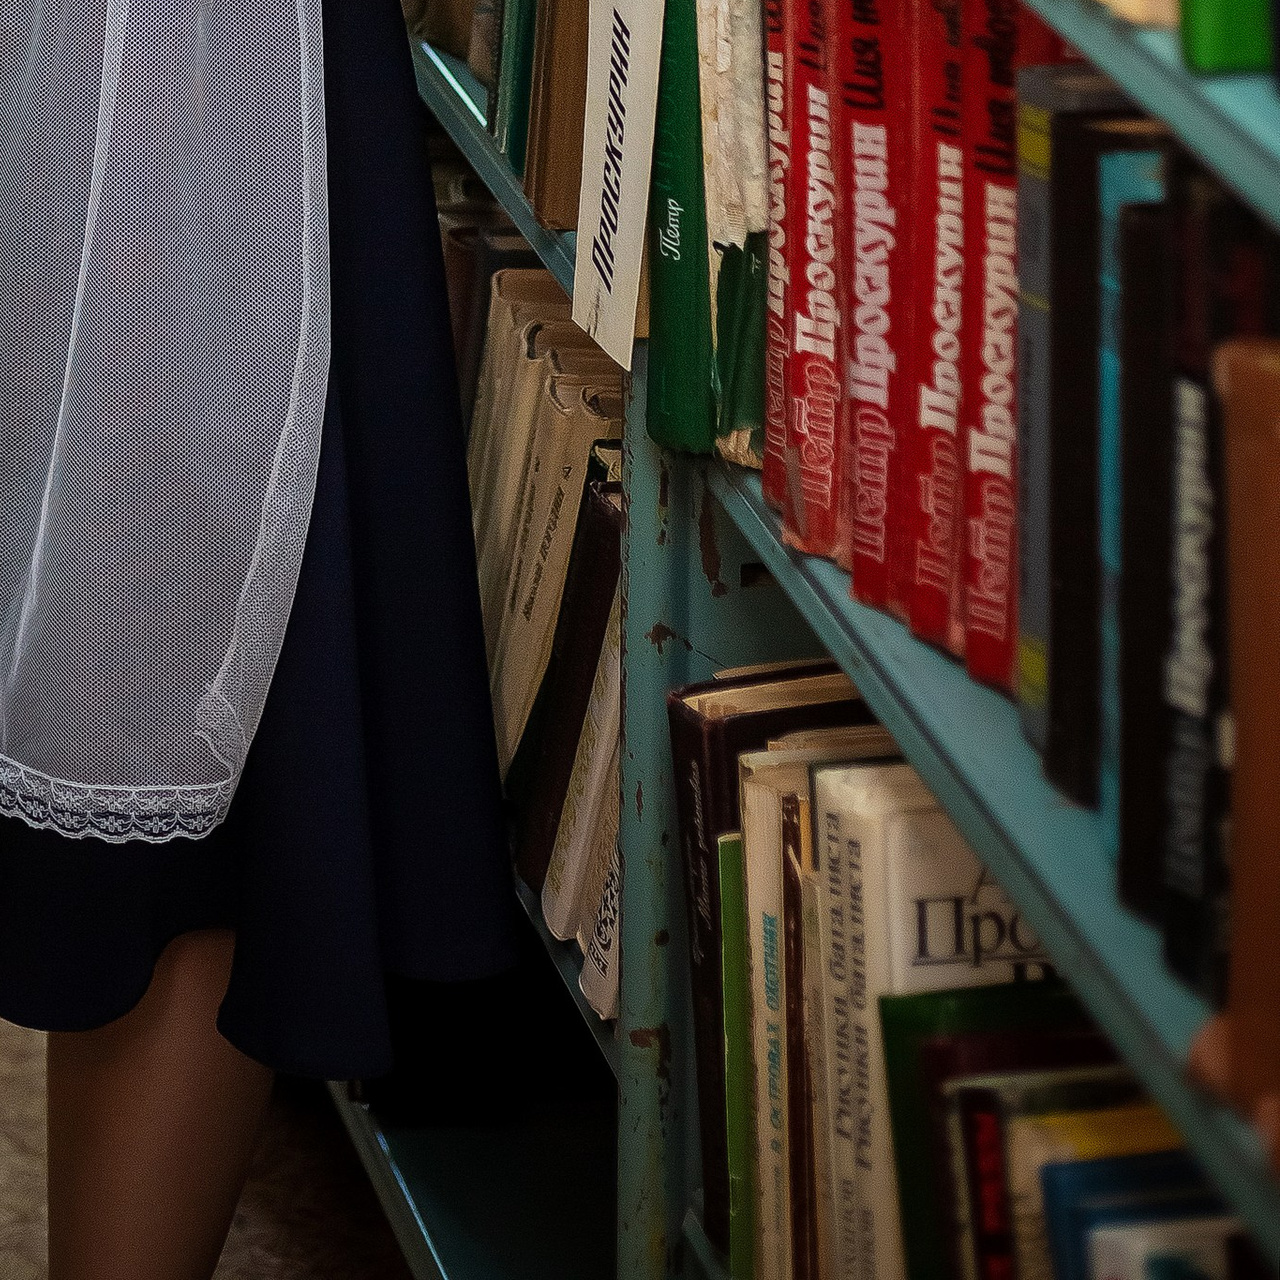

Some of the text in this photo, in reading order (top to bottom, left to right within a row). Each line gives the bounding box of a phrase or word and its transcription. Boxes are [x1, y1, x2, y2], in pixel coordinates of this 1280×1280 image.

[657, 196, 685, 262] Петр
[794, 82, 841, 363] Проскурин
[849, 120, 897, 411] Проскурин
[917, 141, 965, 438] Проскурин
[966, 182, 1019, 480] Проскурин
